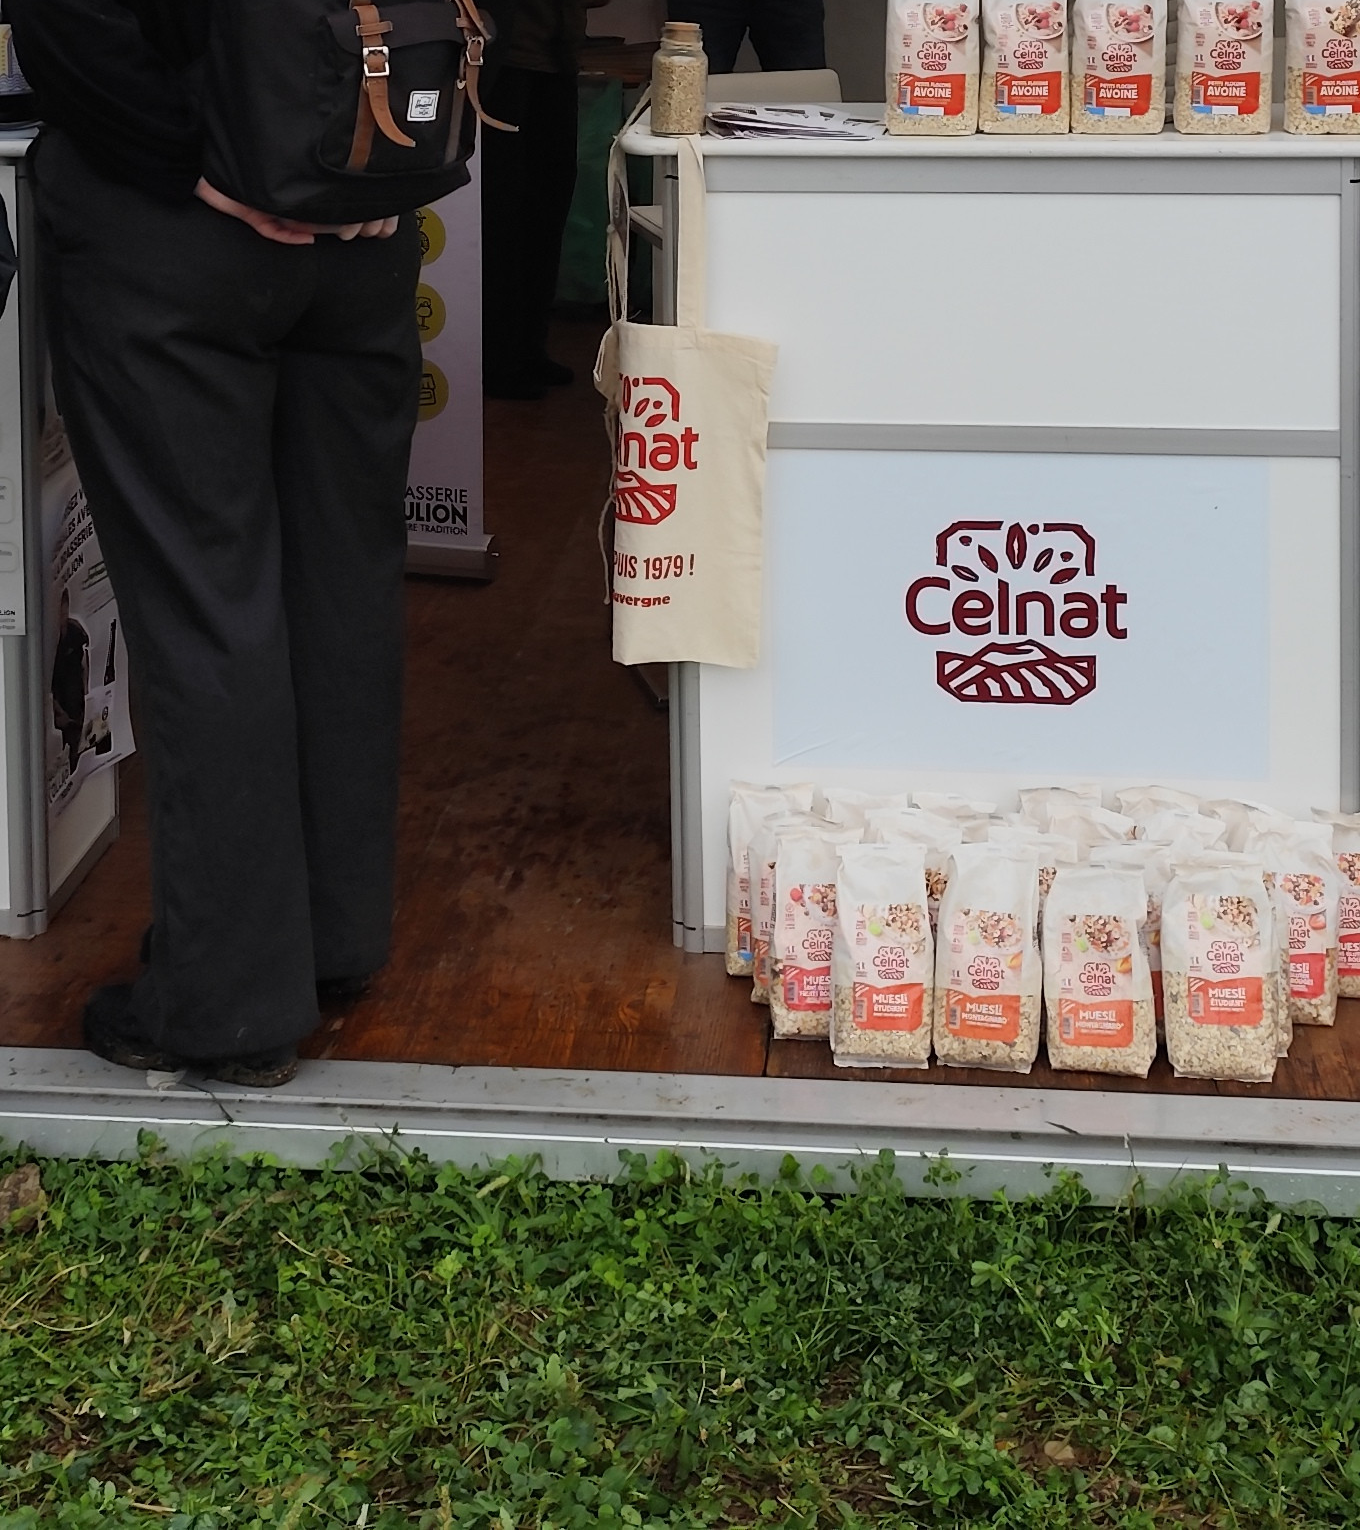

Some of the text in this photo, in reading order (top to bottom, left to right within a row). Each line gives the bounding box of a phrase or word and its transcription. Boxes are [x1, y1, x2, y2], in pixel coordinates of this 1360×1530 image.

[917, 47, 952, 61] Celnat
[1013, 46, 1048, 60] Celnat
[1101, 50, 1137, 64] Celnat
[1209, 47, 1246, 61] Celnat
[1321, 46, 1358, 60] Celnat
[913, 87, 952, 98] AVOINE
[1010, 86, 1049, 97] AVOINE
[1098, 87, 1138, 99] AVOINE
[1207, 85, 1247, 97] AVOINE
[1320, 85, 1359, 96] AVOINE
[421, 524, 468, 536] TRADITION
[643, 554, 683, 580] 1979
[905, 576, 1128, 639] Celnat
[872, 955, 910, 969] Celnat
[1207, 948, 1246, 963] Celnat
[967, 965, 1005, 980] Celnat
[1078, 971, 1117, 986] Celnat
